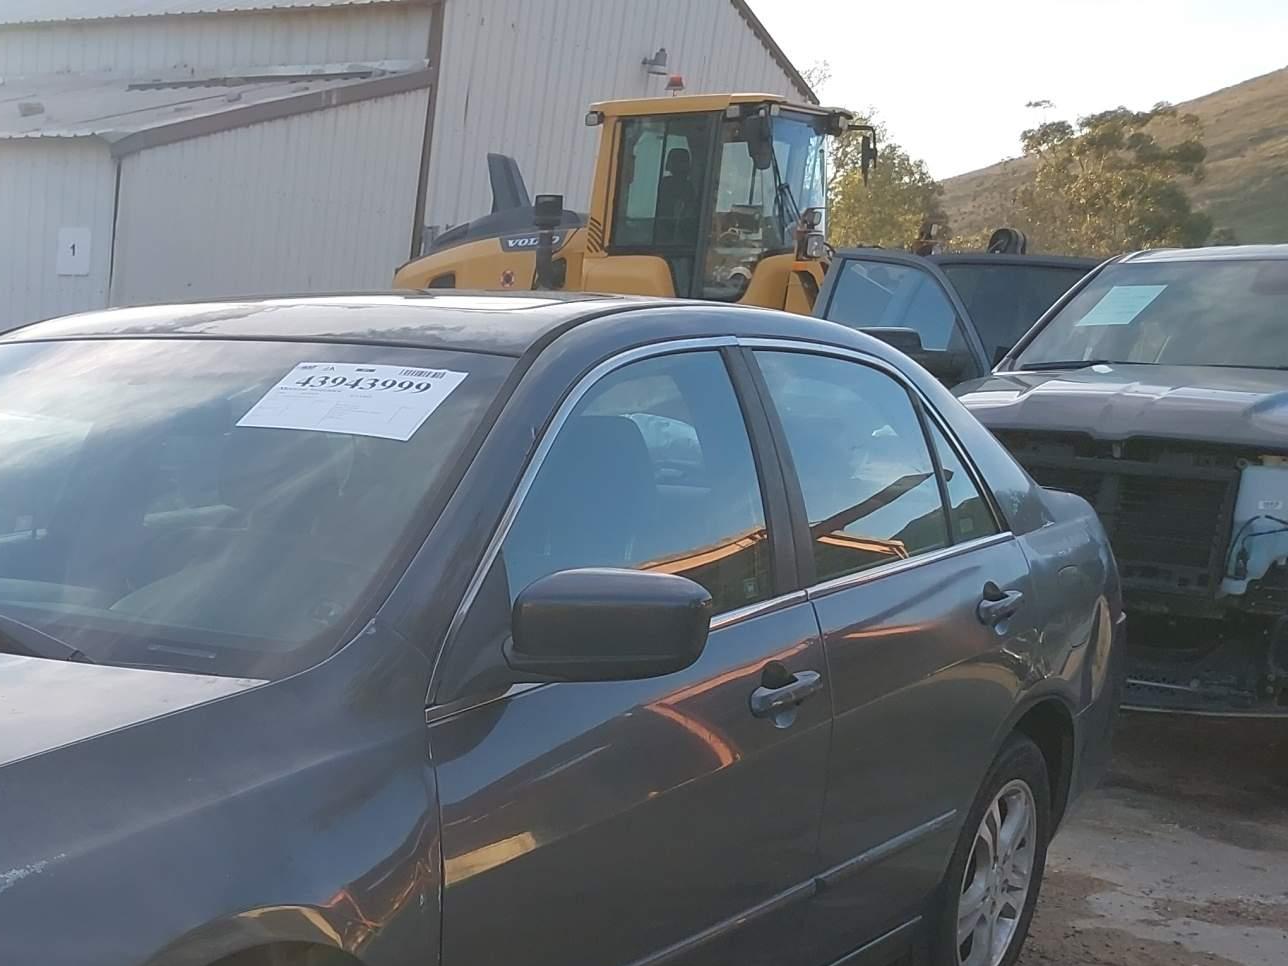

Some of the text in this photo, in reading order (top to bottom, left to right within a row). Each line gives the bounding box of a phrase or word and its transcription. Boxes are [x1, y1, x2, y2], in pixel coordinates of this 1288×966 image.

[508, 235, 560, 248] VOLO
[70, 243, 76, 257] 1
[295, 374, 432, 394] 43943999
